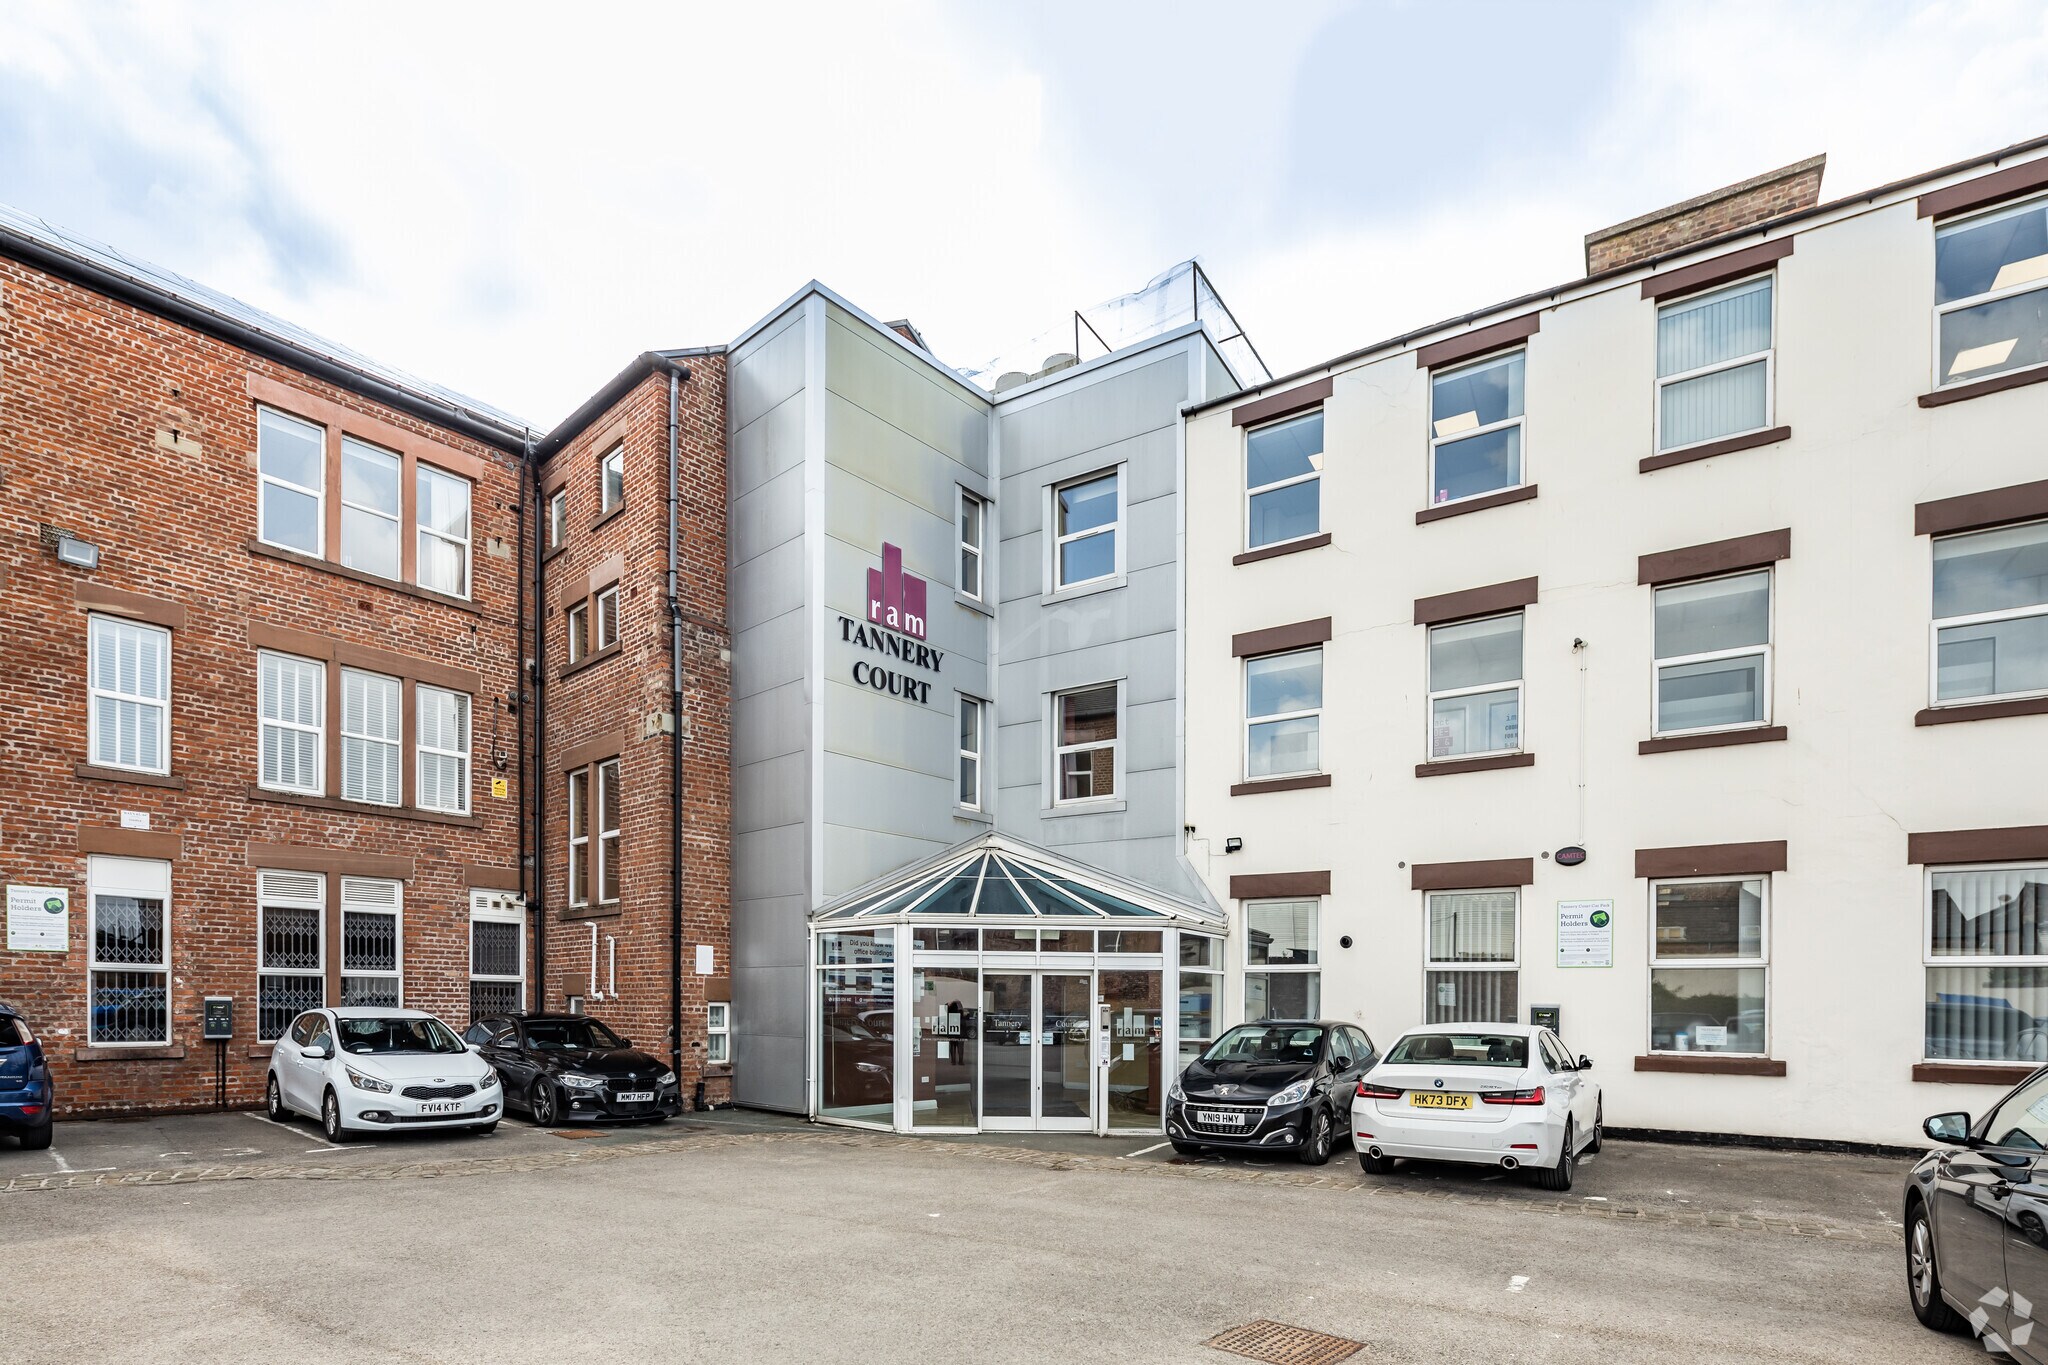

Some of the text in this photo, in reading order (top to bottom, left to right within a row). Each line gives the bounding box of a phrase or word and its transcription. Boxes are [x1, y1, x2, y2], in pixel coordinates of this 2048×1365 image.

[871, 599, 925, 637] ram
[838, 615, 945, 673] TANNERY
[853, 661, 932, 704] COURT
[1556, 852, 1585, 860] CAMTEC
[853, 948, 893, 957] office buildings
[932, 1023, 960, 1033] ram
[993, 1018, 1023, 1029] Tannery
[1117, 1026, 1144, 1035] ram
[620, 1093, 651, 1101] MM17 HFP
[1414, 1094, 1468, 1107] HK73 DFX
[421, 1102, 462, 1112] FV14 KTF
[1202, 1112, 1240, 1124] YN19 HMY
